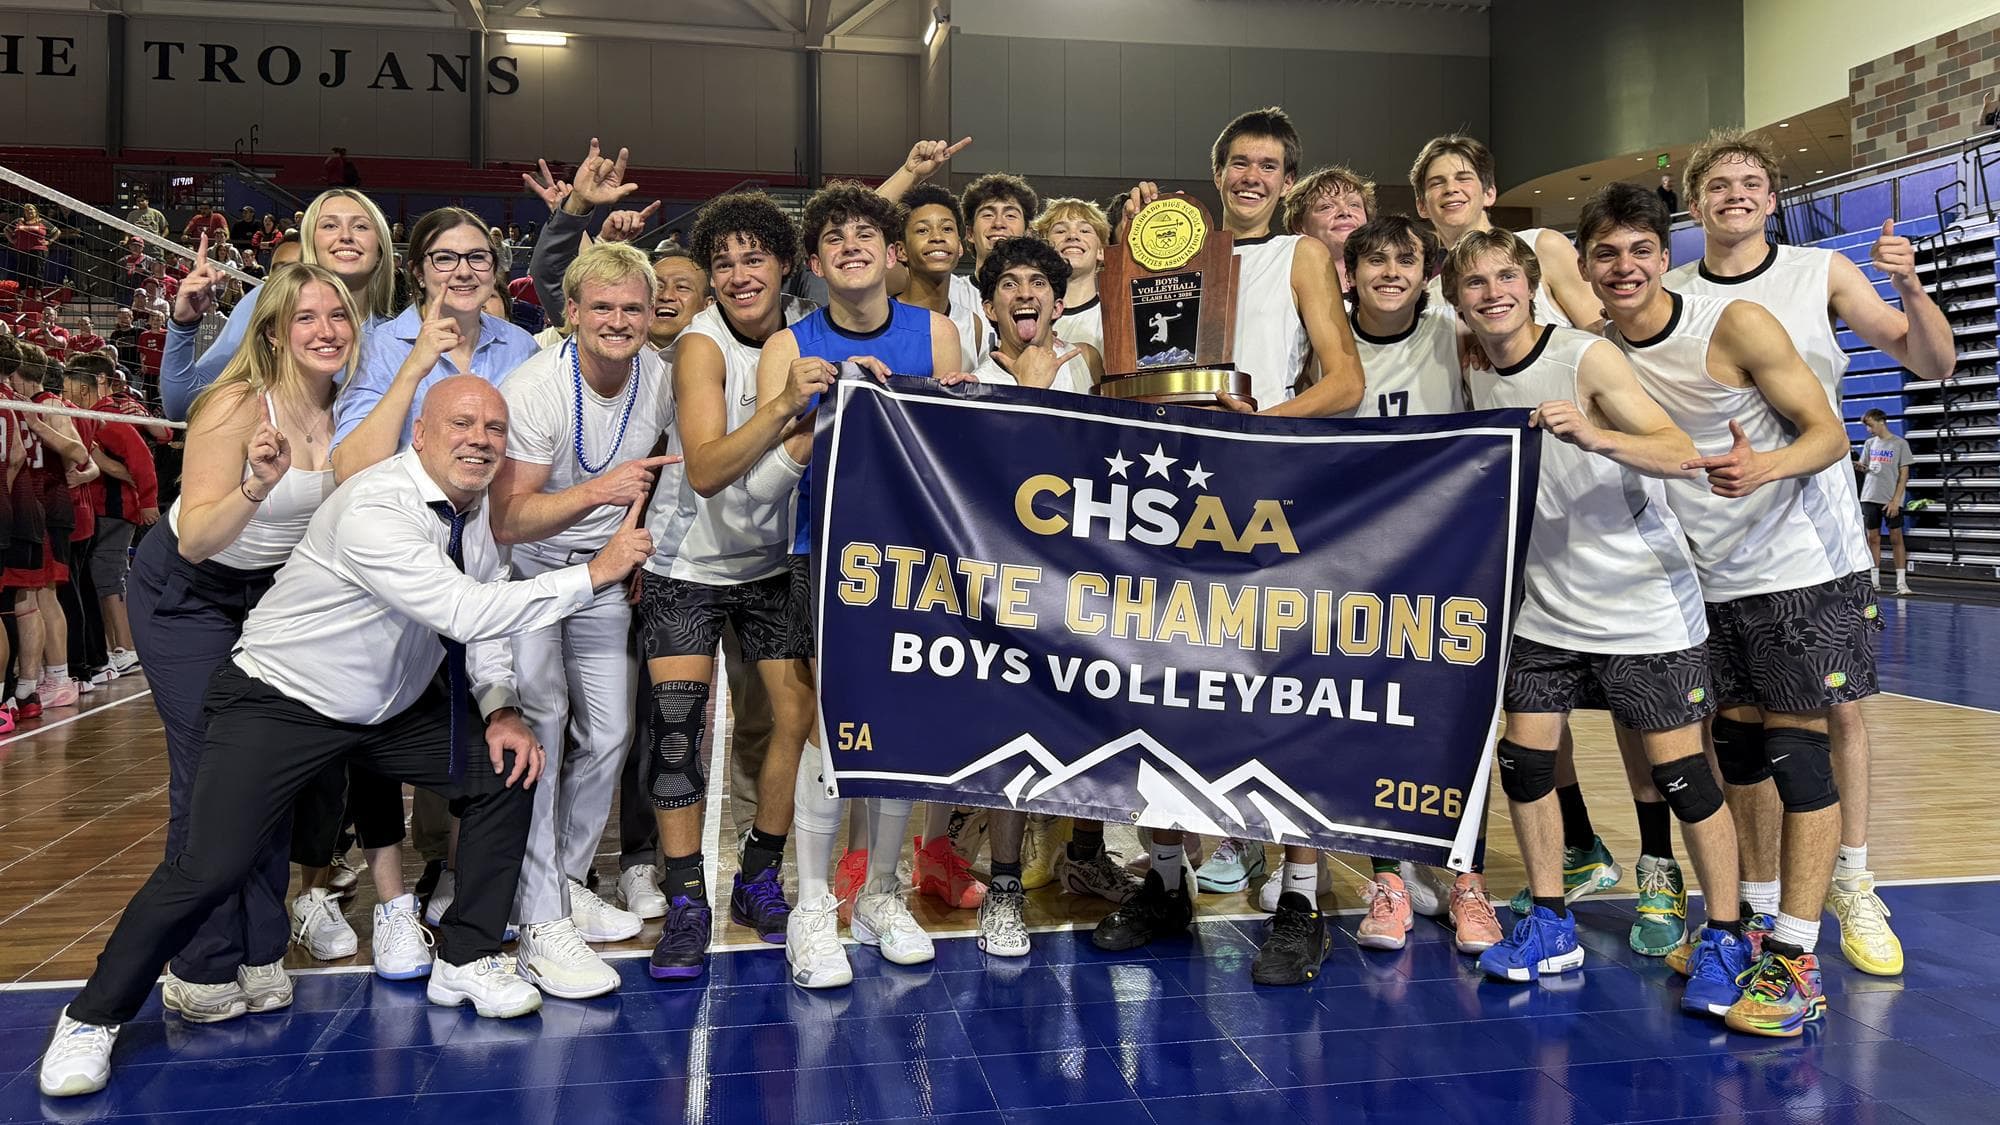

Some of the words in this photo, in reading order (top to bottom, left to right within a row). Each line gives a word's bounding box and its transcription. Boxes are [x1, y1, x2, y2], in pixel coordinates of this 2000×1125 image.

[144, 41, 519, 95] TROJANS
[1138, 282, 1197, 295] VOLLEYBALL
[1155, 276, 1179, 286] BOYS
[1014, 473, 1301, 554] CHSAA
[838, 541, 1042, 630] STATE
[1064, 570, 1488, 666] CHAMPIONS
[890, 632, 1031, 684] BOYS
[1047, 654, 1415, 727] VOLLEYBALL
[838, 722, 873, 751] 5A
[1375, 778, 1463, 819] 2026
